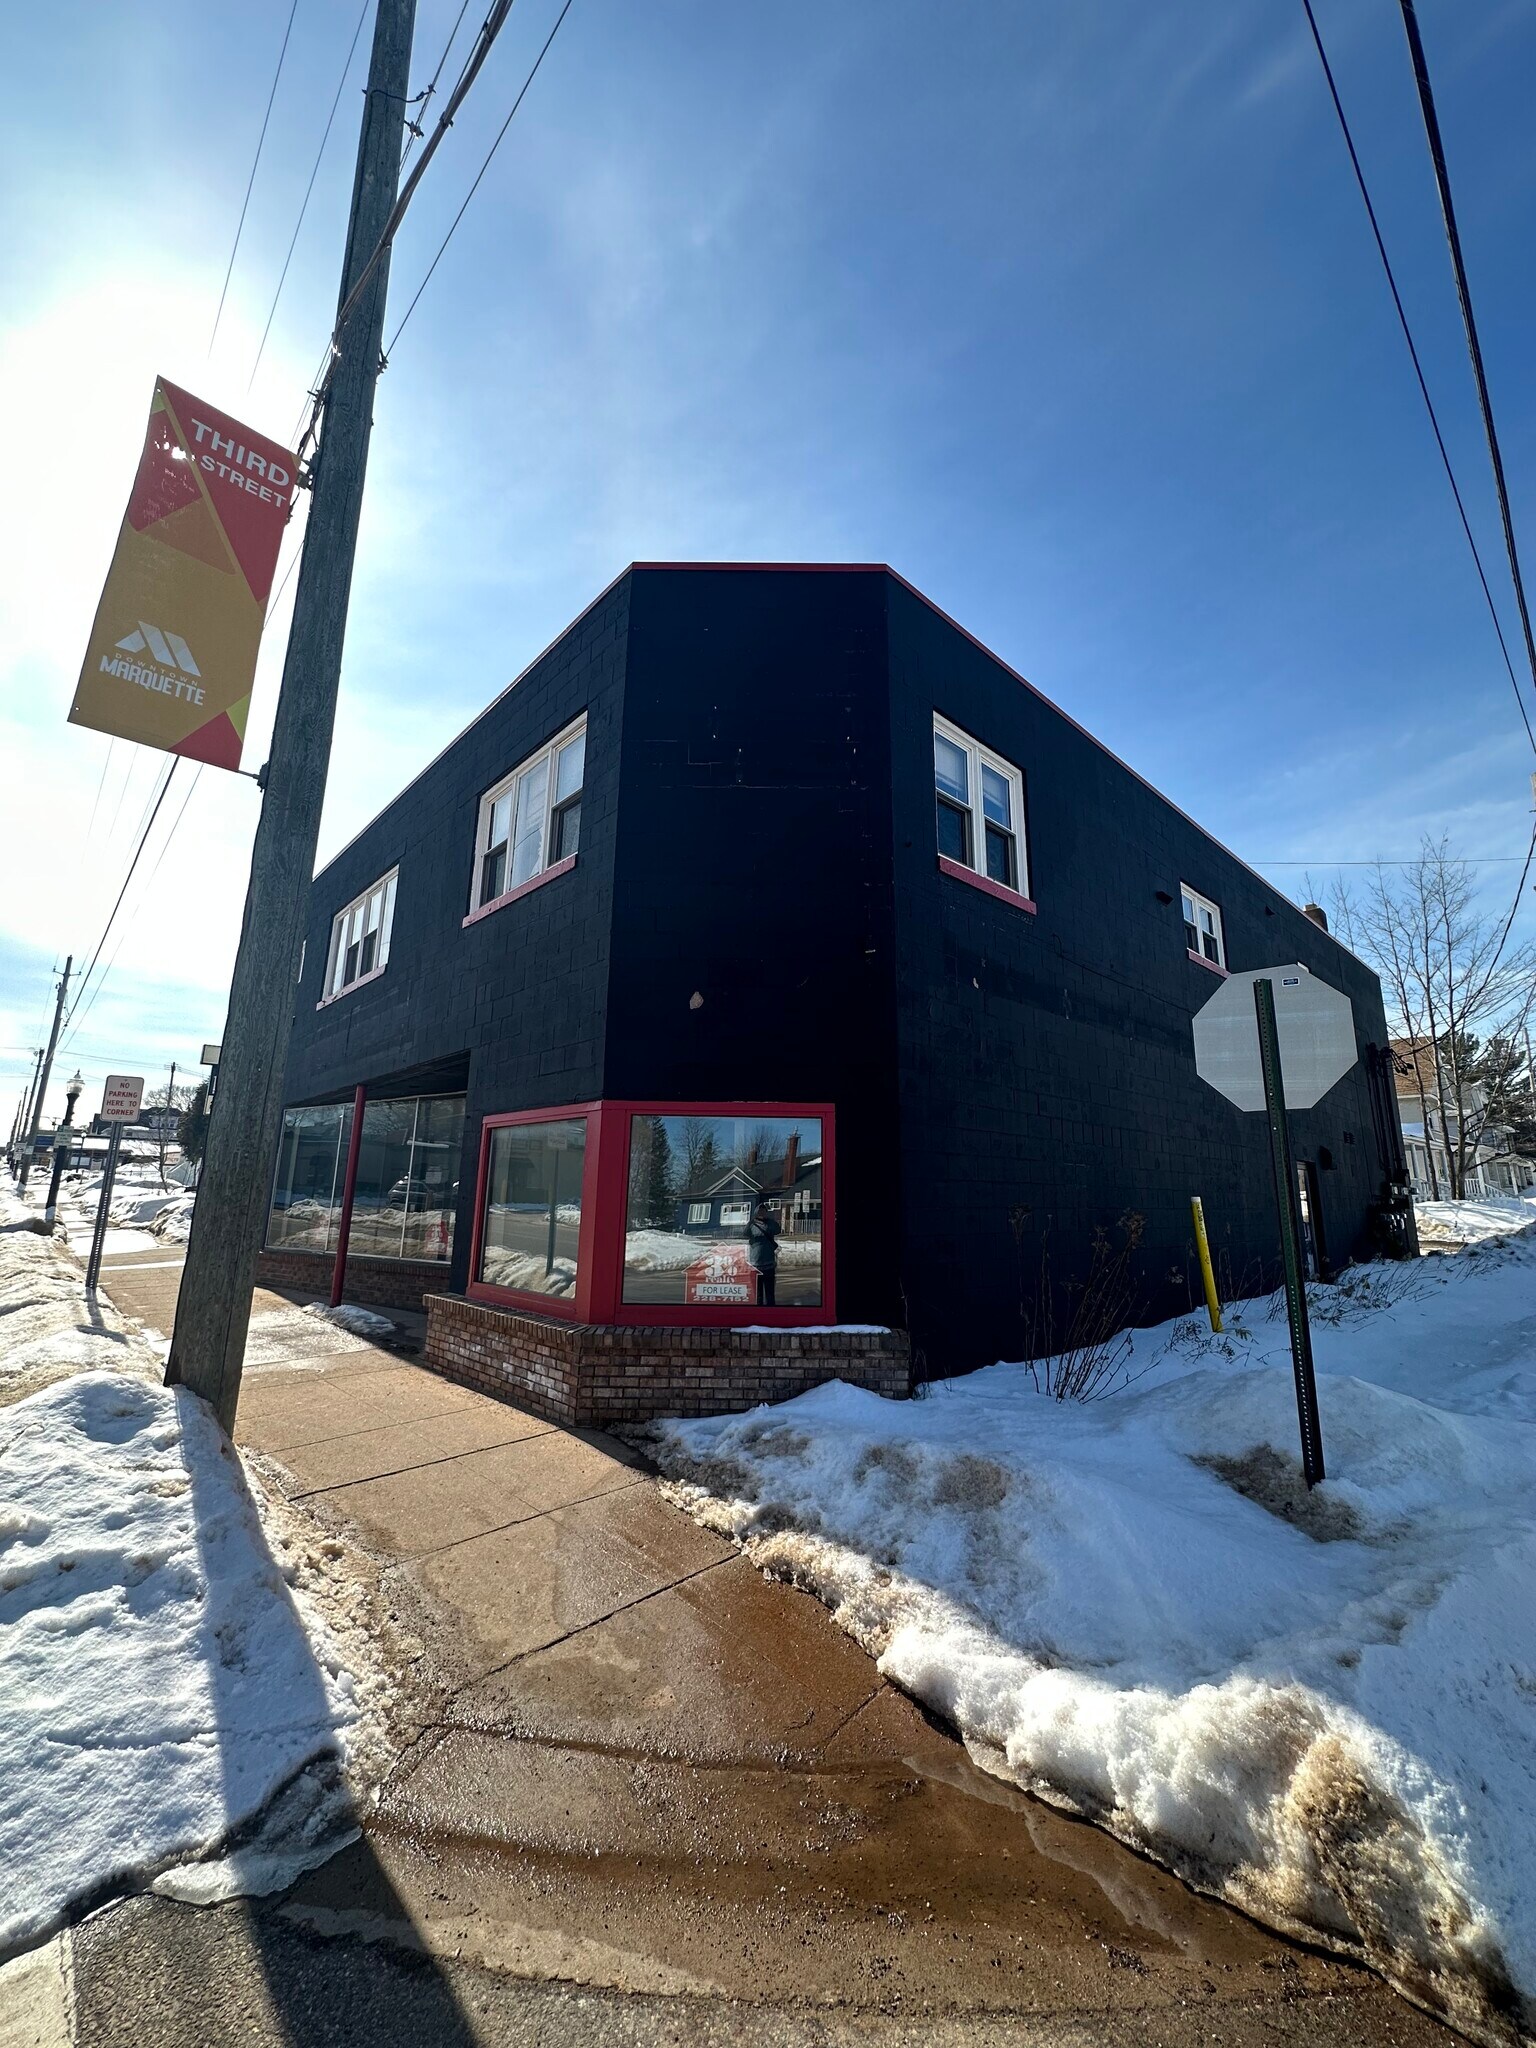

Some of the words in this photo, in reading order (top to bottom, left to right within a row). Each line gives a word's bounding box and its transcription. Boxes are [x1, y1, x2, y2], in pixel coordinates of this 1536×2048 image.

[191, 417, 290, 487] THIRD
[200, 454, 287, 508] STREET
[99, 654, 206, 706] MARQUETTE
[115, 652, 198, 686] DOWNTOWN
